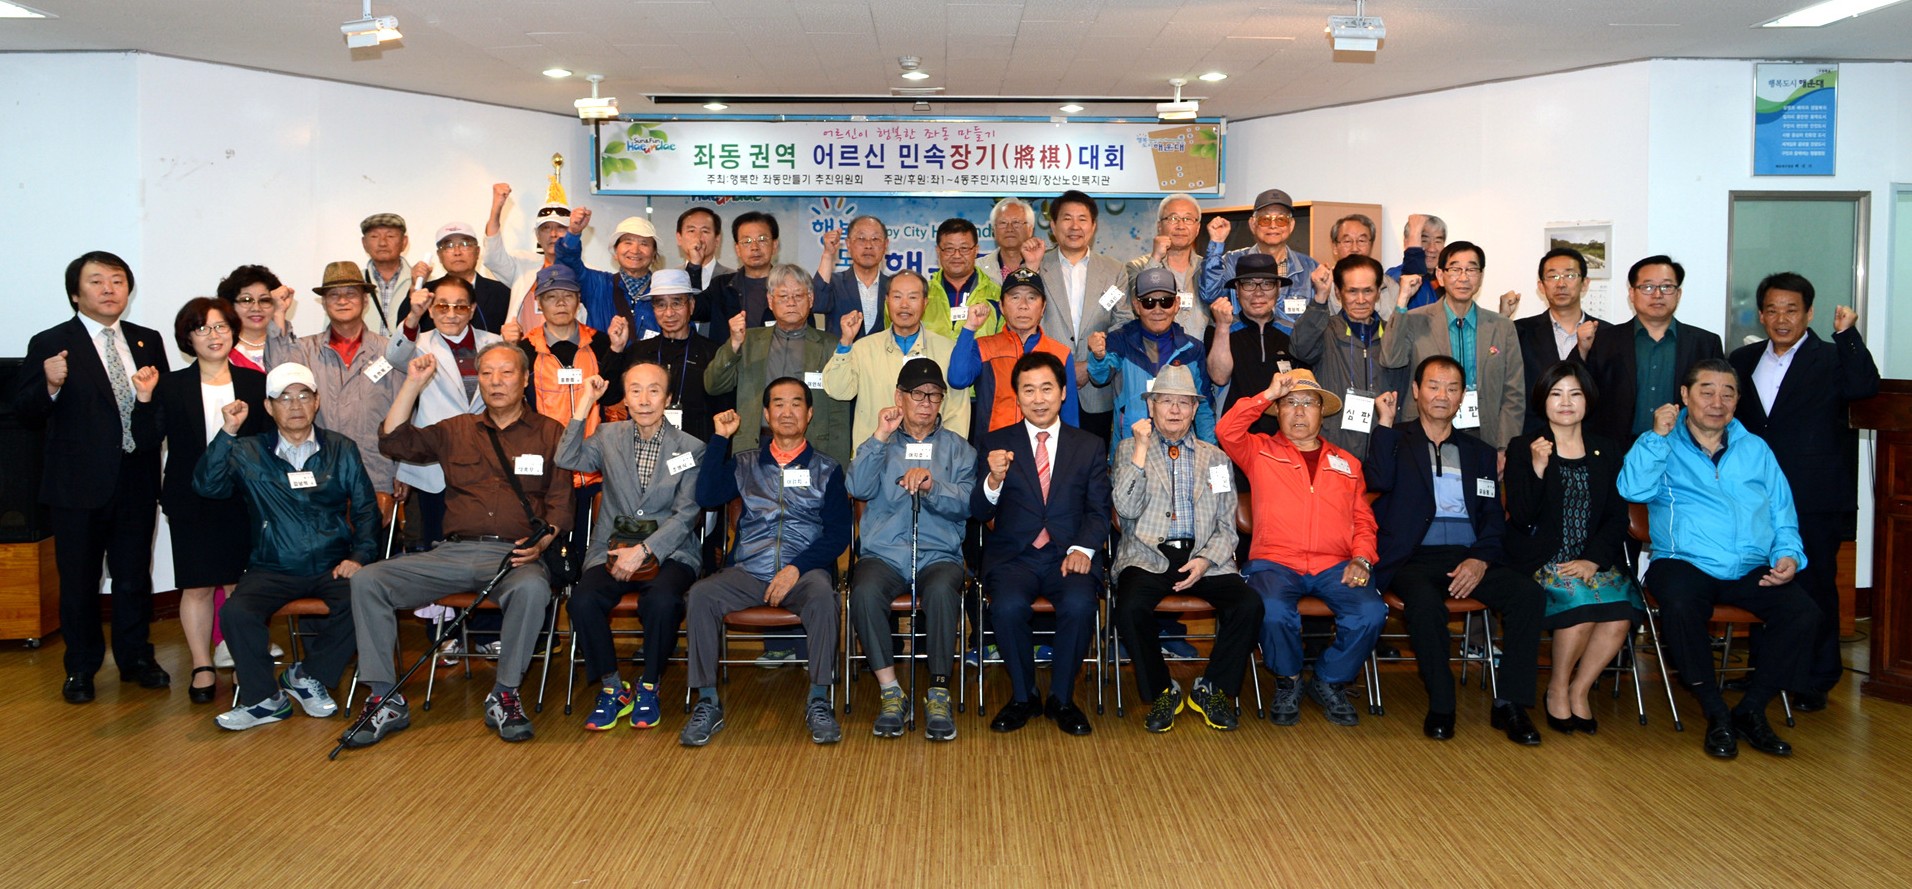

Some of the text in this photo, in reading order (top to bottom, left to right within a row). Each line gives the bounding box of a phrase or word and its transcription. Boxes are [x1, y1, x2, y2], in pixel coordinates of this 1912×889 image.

[823, 126, 995, 142] 어르신이 행복한 좌동 만들기
[694, 143, 741, 170] 좌동
[749, 143, 795, 170] 권역
[813, 143, 884, 170] 어르신
[763, 174, 811, 185] 좌동만들기
[815, 174, 863, 185] 추진위원회
[903, 226, 928, 240] City
